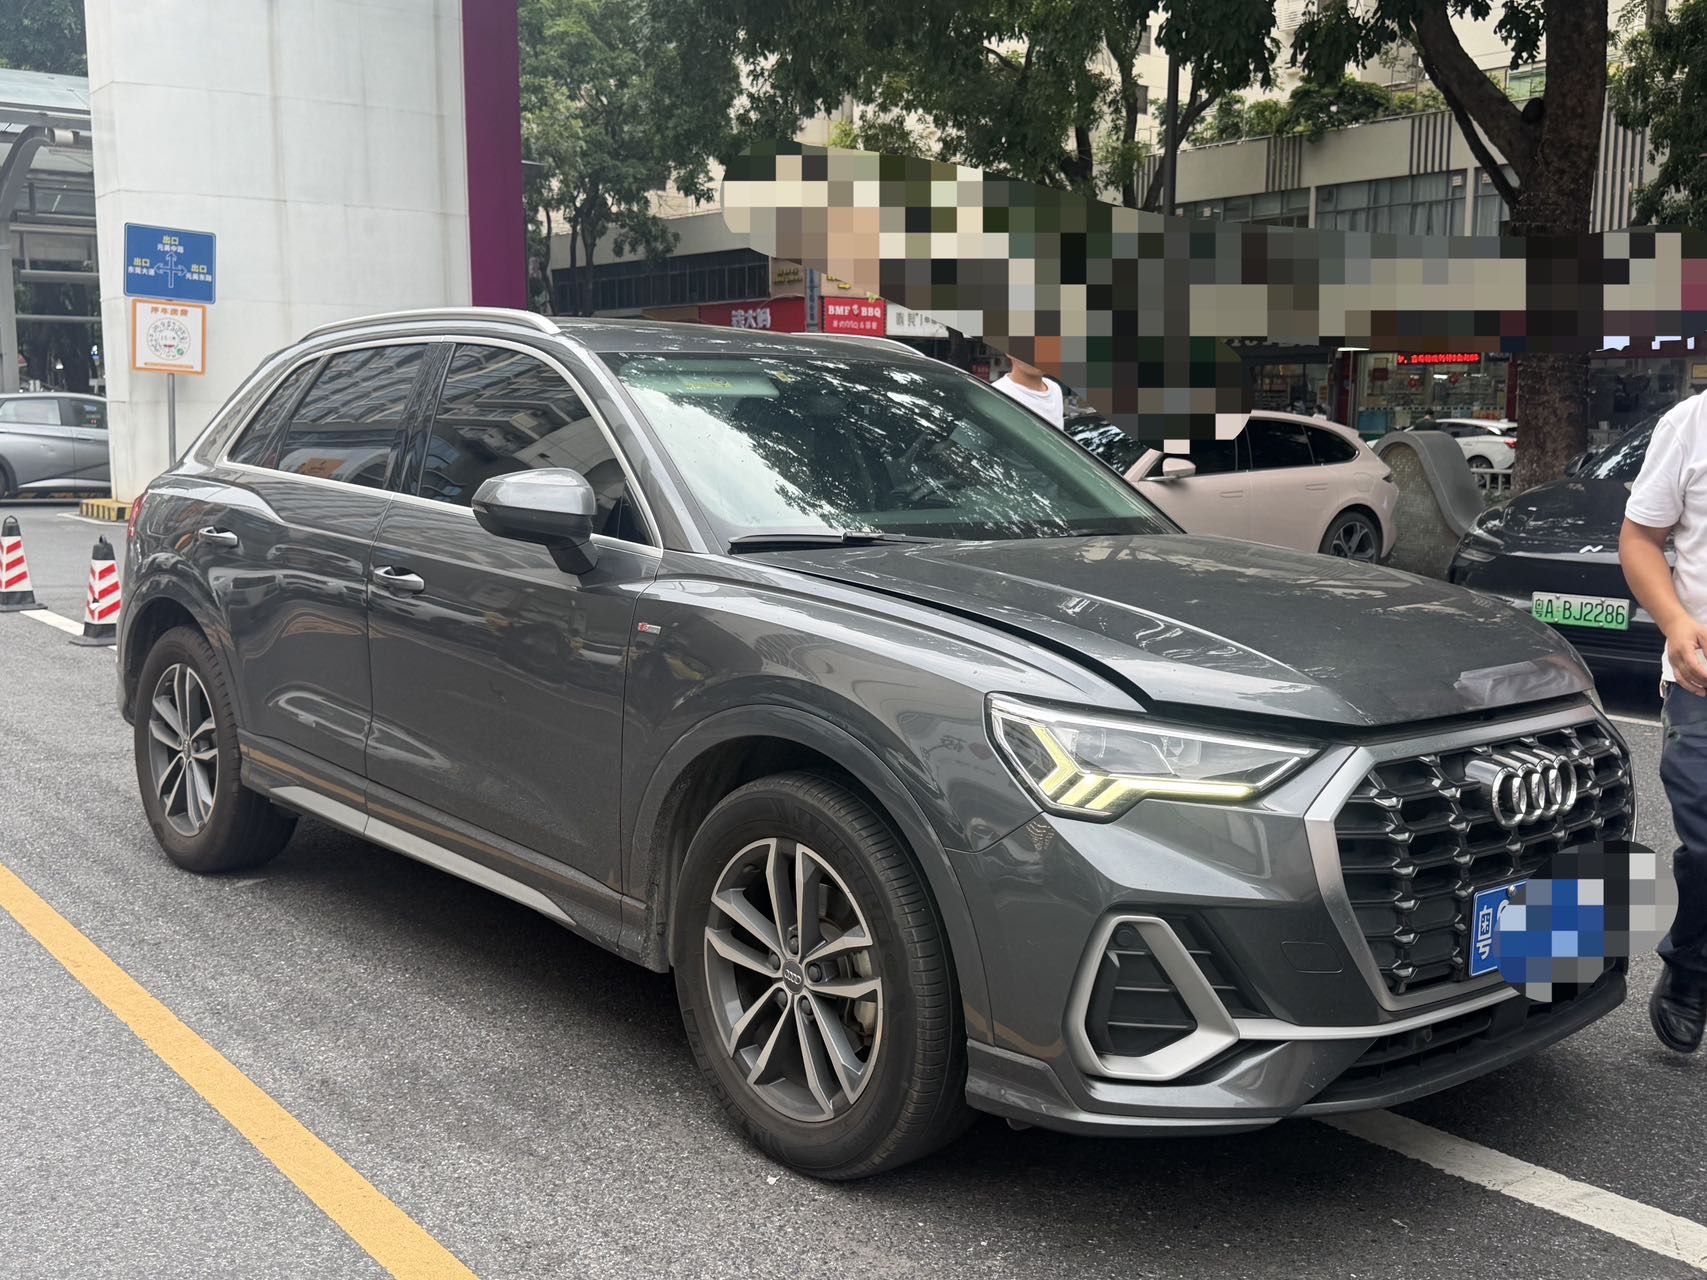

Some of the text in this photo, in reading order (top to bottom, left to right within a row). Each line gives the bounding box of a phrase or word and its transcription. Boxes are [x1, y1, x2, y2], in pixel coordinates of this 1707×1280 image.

[163, 235, 179, 245] 出口
[133, 257, 150, 266] 出口
[191, 264, 208, 273] 出口
[828, 305, 881, 317] BMF BBQ
